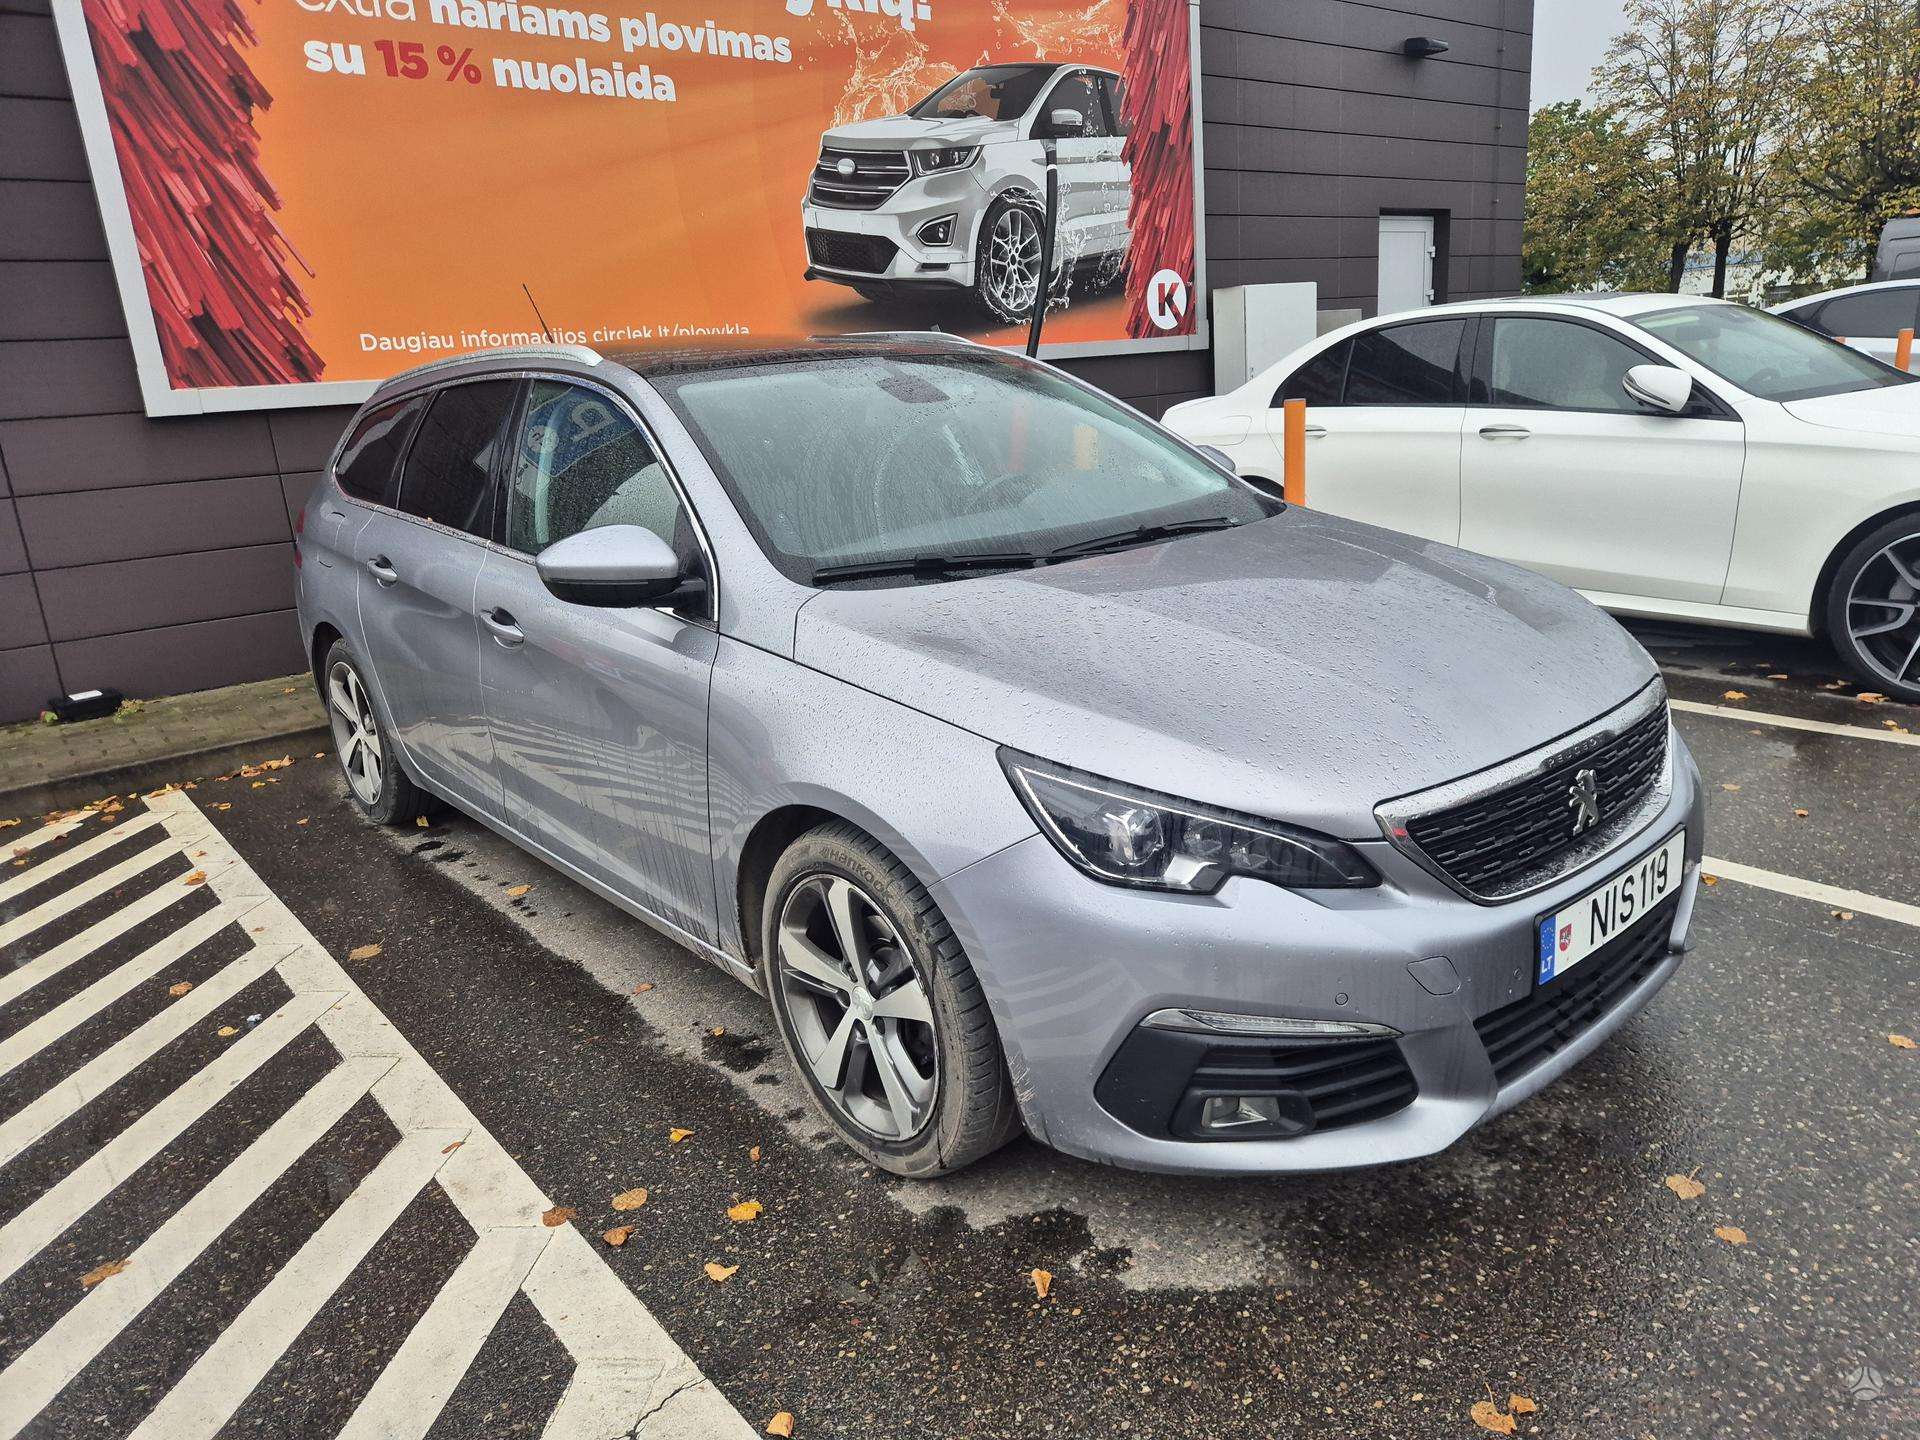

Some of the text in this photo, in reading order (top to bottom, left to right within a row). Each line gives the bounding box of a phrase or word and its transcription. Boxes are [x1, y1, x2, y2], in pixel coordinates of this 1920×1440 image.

[429, 0, 612, 43] nariams
[619, 11, 793, 63] plovimas
[303, 39, 677, 102] su 15 % nuolaida
[359, 331, 455, 353] Daugiau
[1589, 847, 1669, 946] NIS 119
